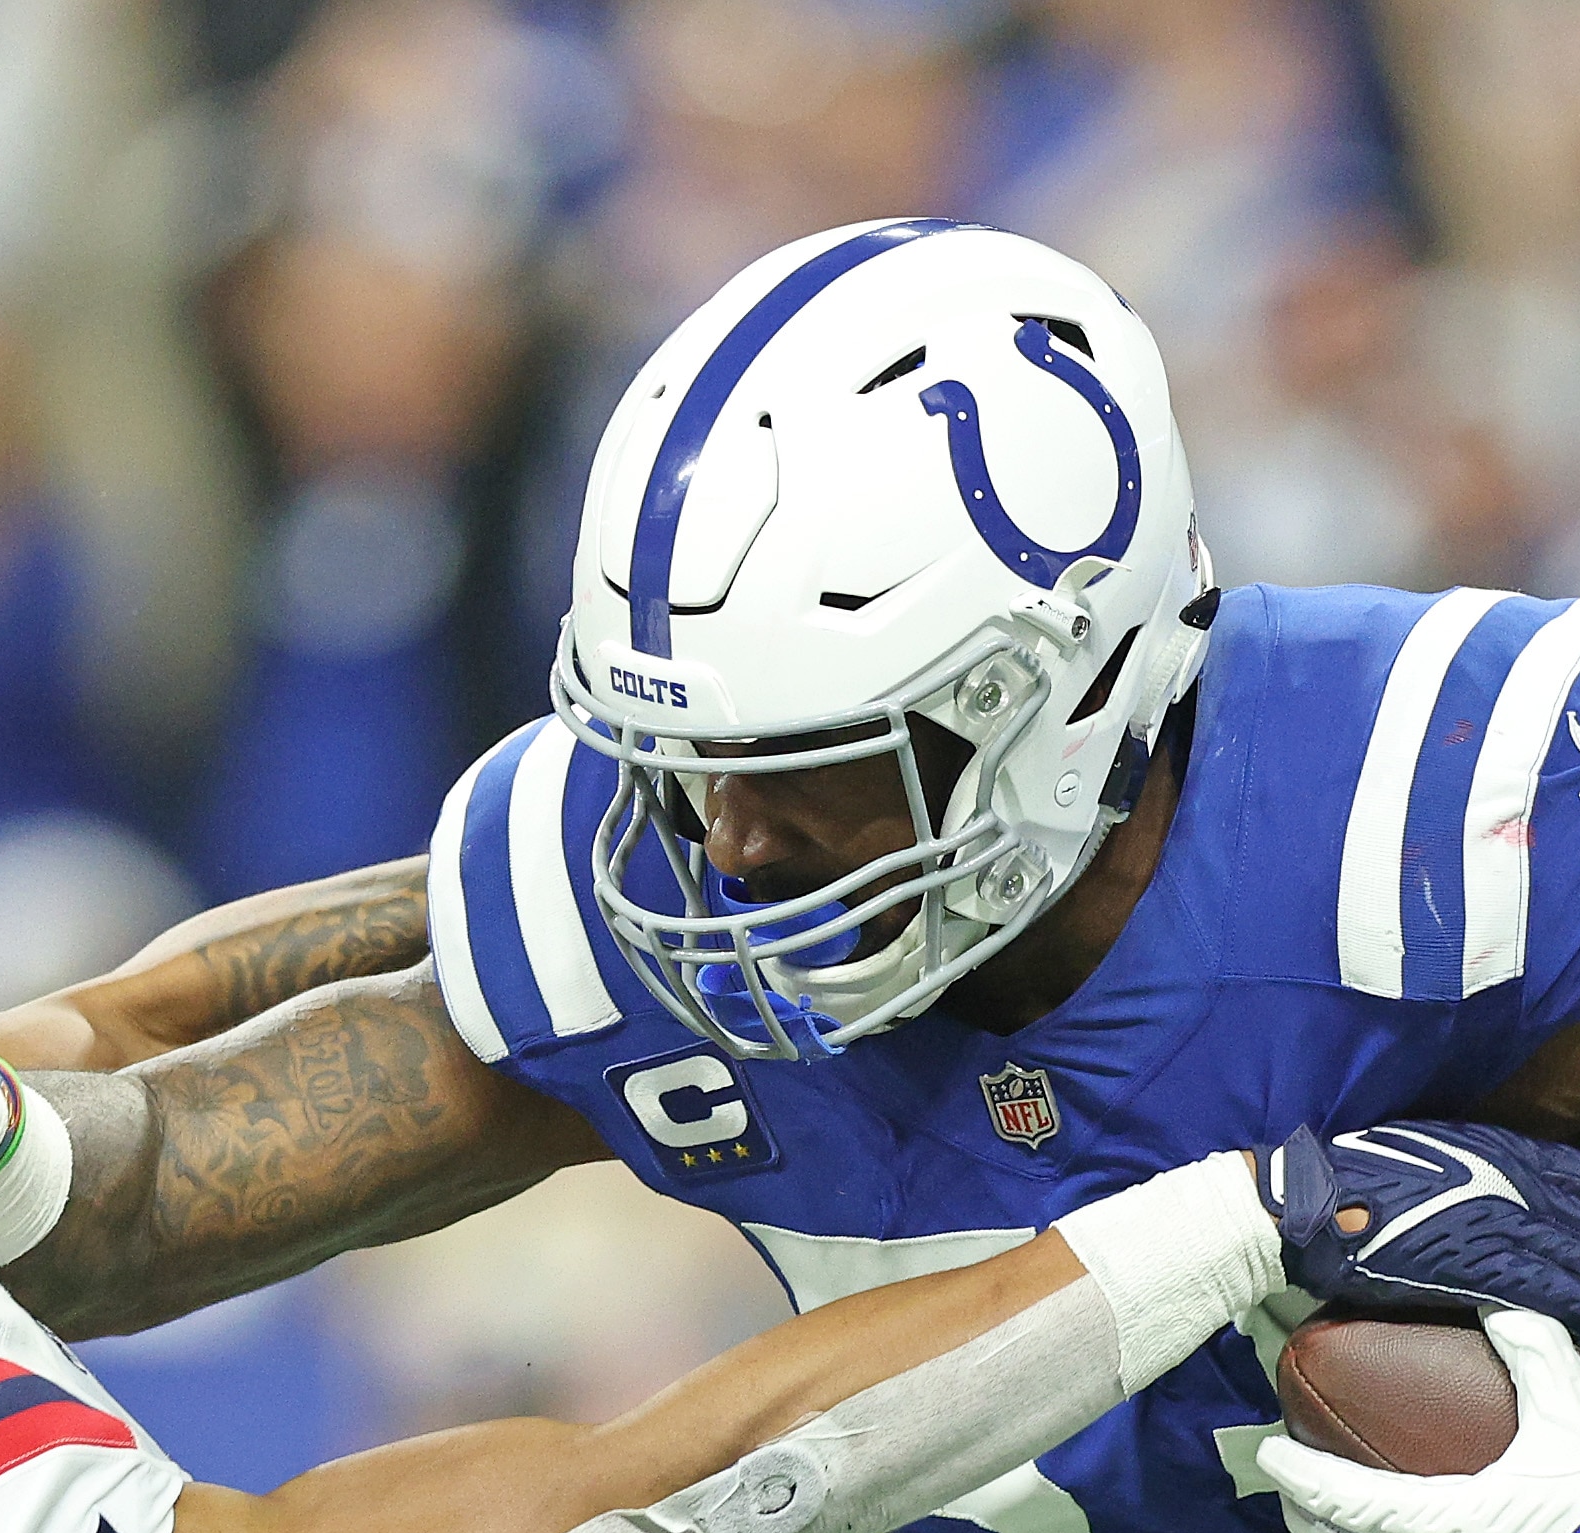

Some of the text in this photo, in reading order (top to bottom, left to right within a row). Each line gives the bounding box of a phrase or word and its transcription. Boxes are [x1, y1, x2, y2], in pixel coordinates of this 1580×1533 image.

[610, 665, 688, 709] COLTS
[623, 1054, 749, 1148] C
[998, 1100, 1050, 1135] NFL
